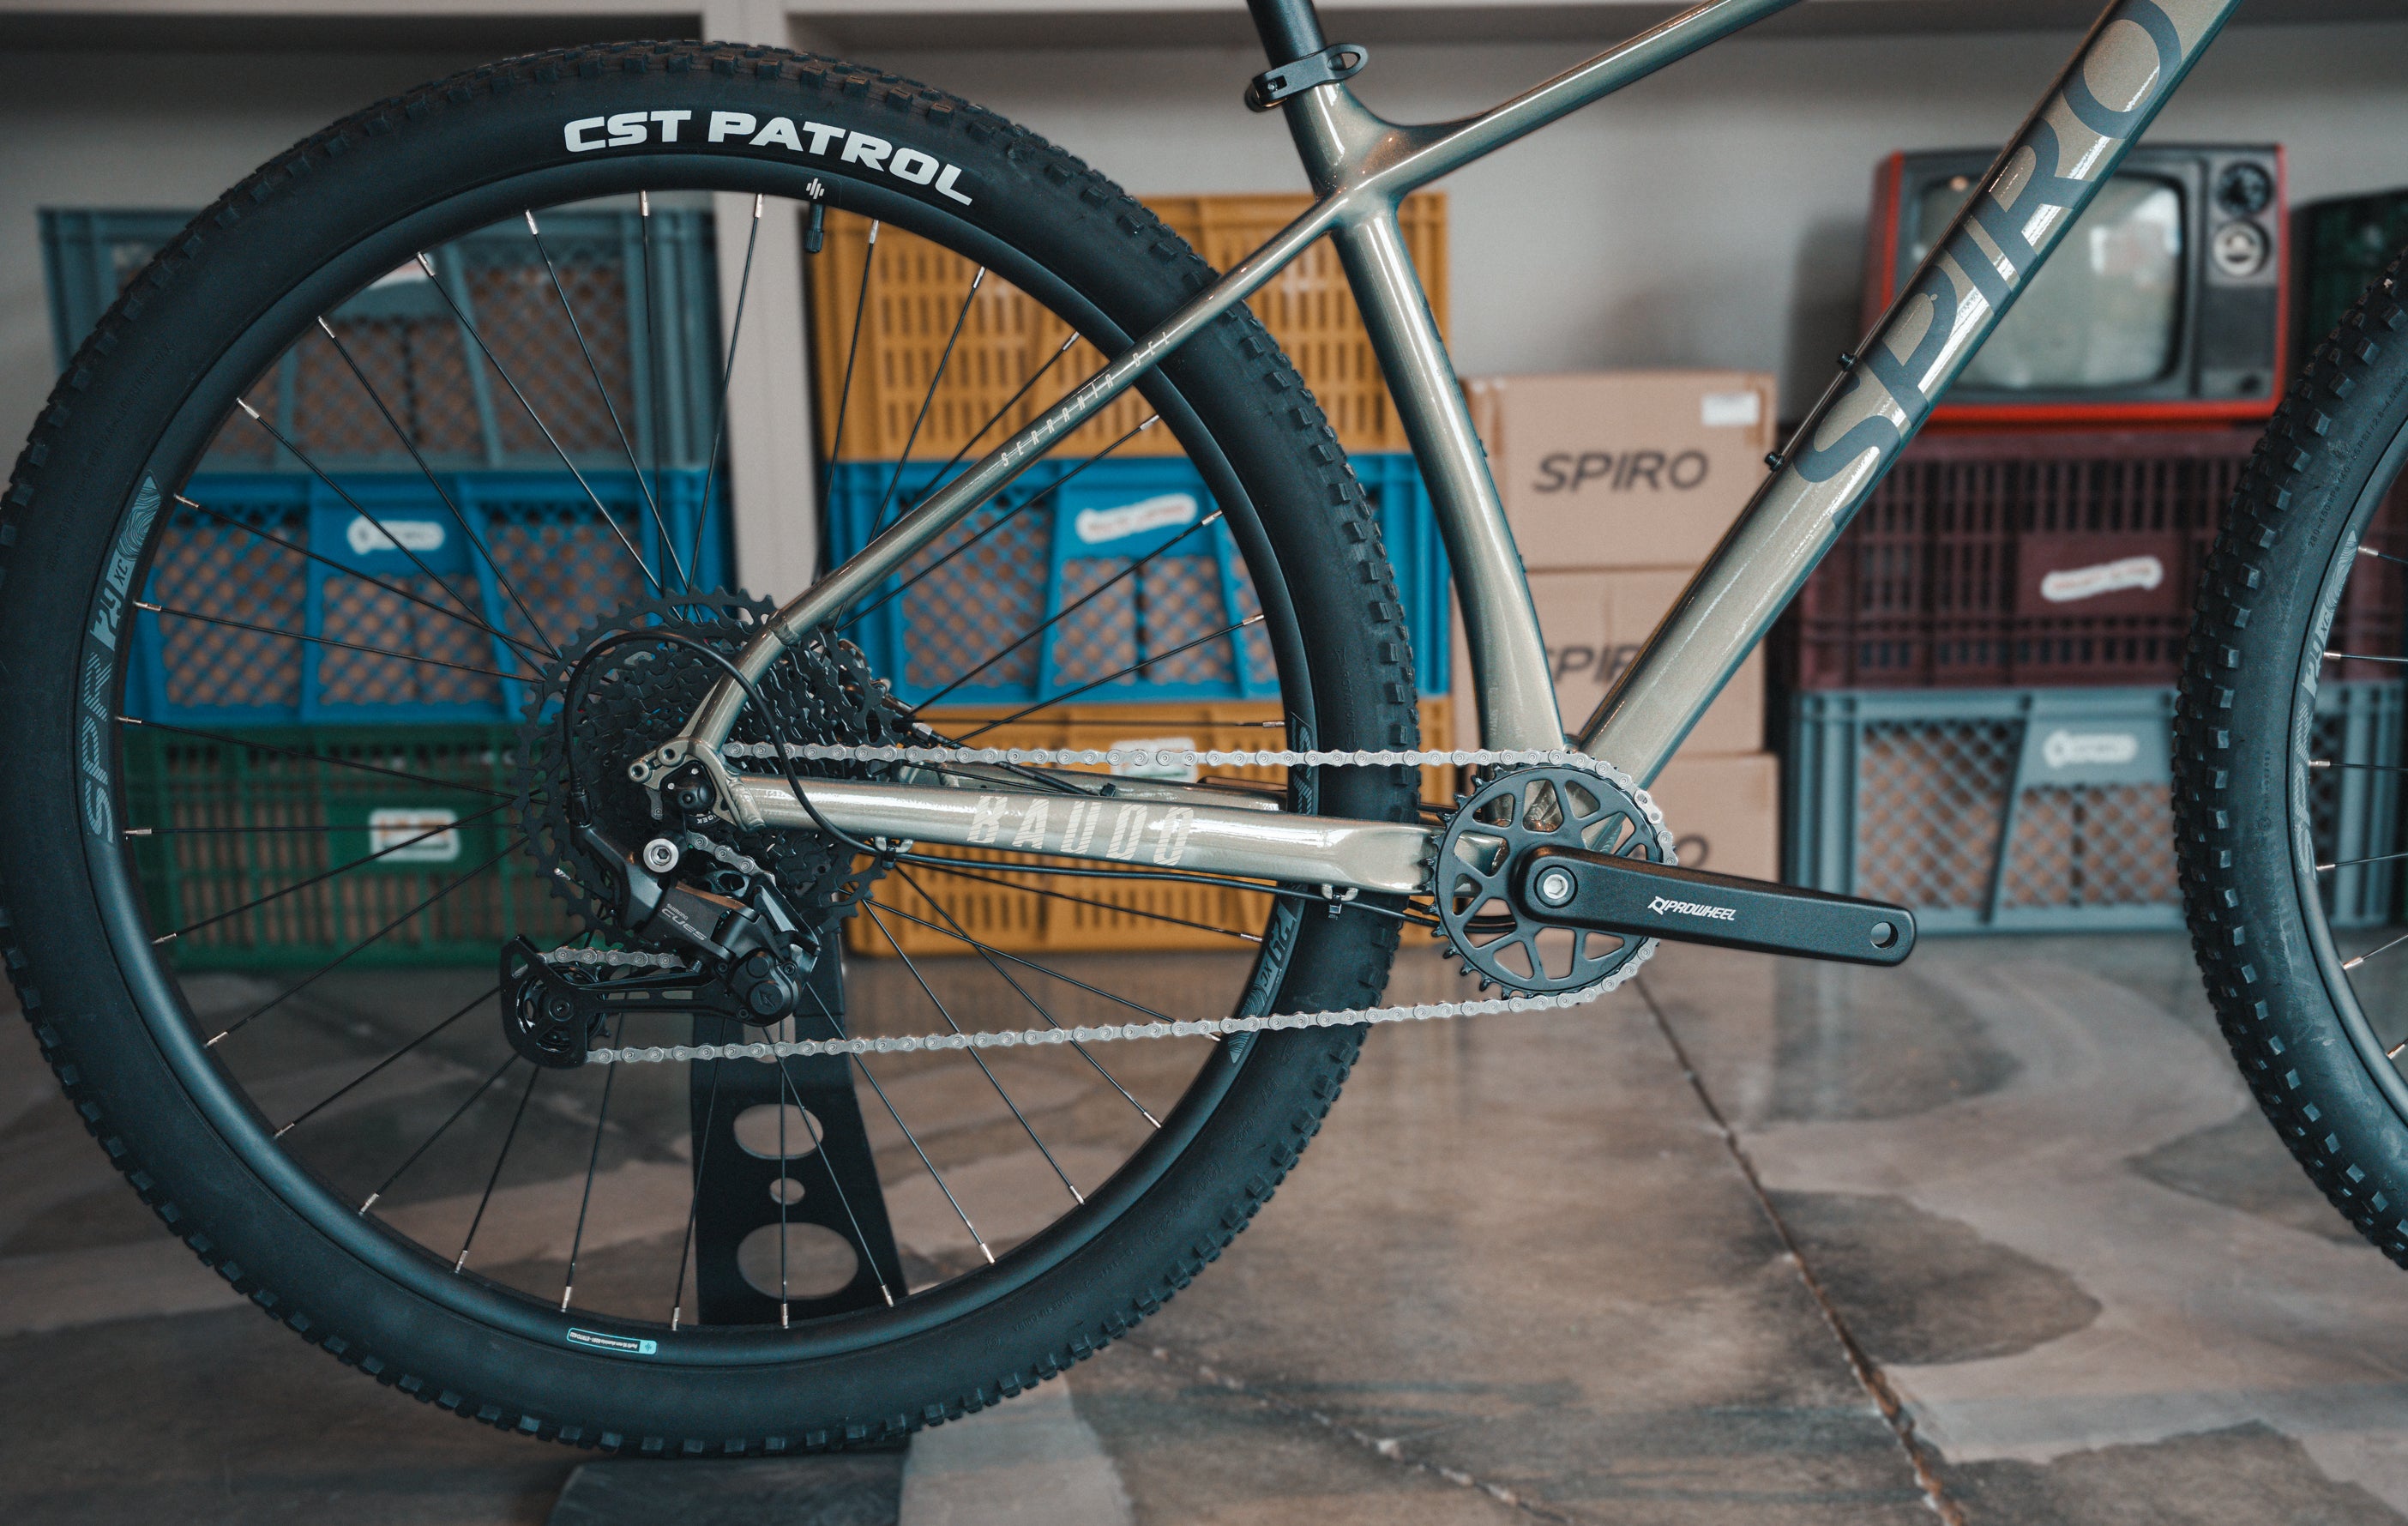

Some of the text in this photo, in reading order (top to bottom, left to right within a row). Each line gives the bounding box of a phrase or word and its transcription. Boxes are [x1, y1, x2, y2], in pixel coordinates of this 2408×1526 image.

[563, 110, 973, 206] CST PATROL
[1793, 0, 2182, 530] SPIRO
[1001, 374, 1114, 467] SERRANIA
[1532, 448, 1710, 492] SPIRO
[114, 560, 130, 588] XC
[967, 796, 1194, 866] BAUDO
[661, 908, 707, 941] CUES
[666, 903, 689, 920] SHIMANO
[1664, 900, 1737, 921] PROWHEEL
[1260, 966, 1273, 988] XC
